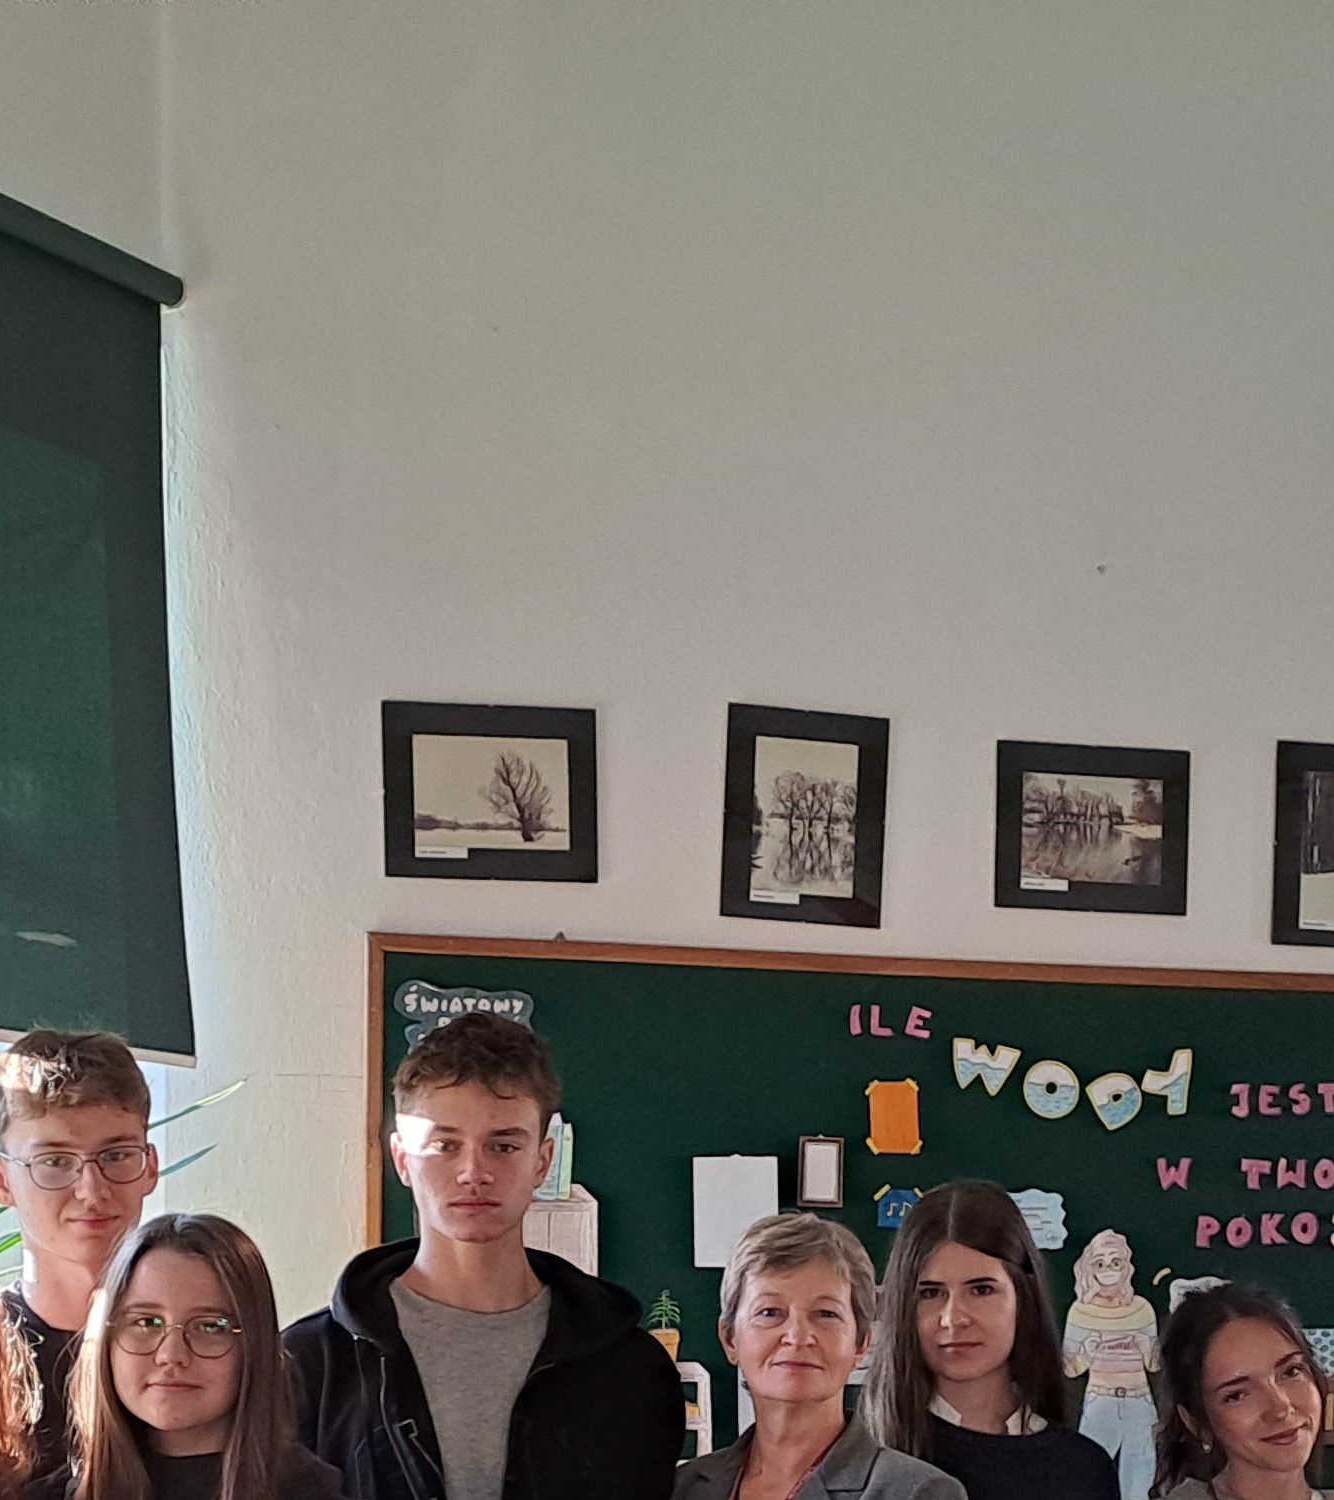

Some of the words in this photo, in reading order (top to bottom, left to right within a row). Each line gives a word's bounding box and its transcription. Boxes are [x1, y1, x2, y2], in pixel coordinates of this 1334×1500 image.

[404, 984, 524, 1014] ŚWIATOWY
[848, 1003, 933, 1038] ILE
[952, 1036, 1193, 1131] WODY
[1156, 1157, 1192, 1191] W
